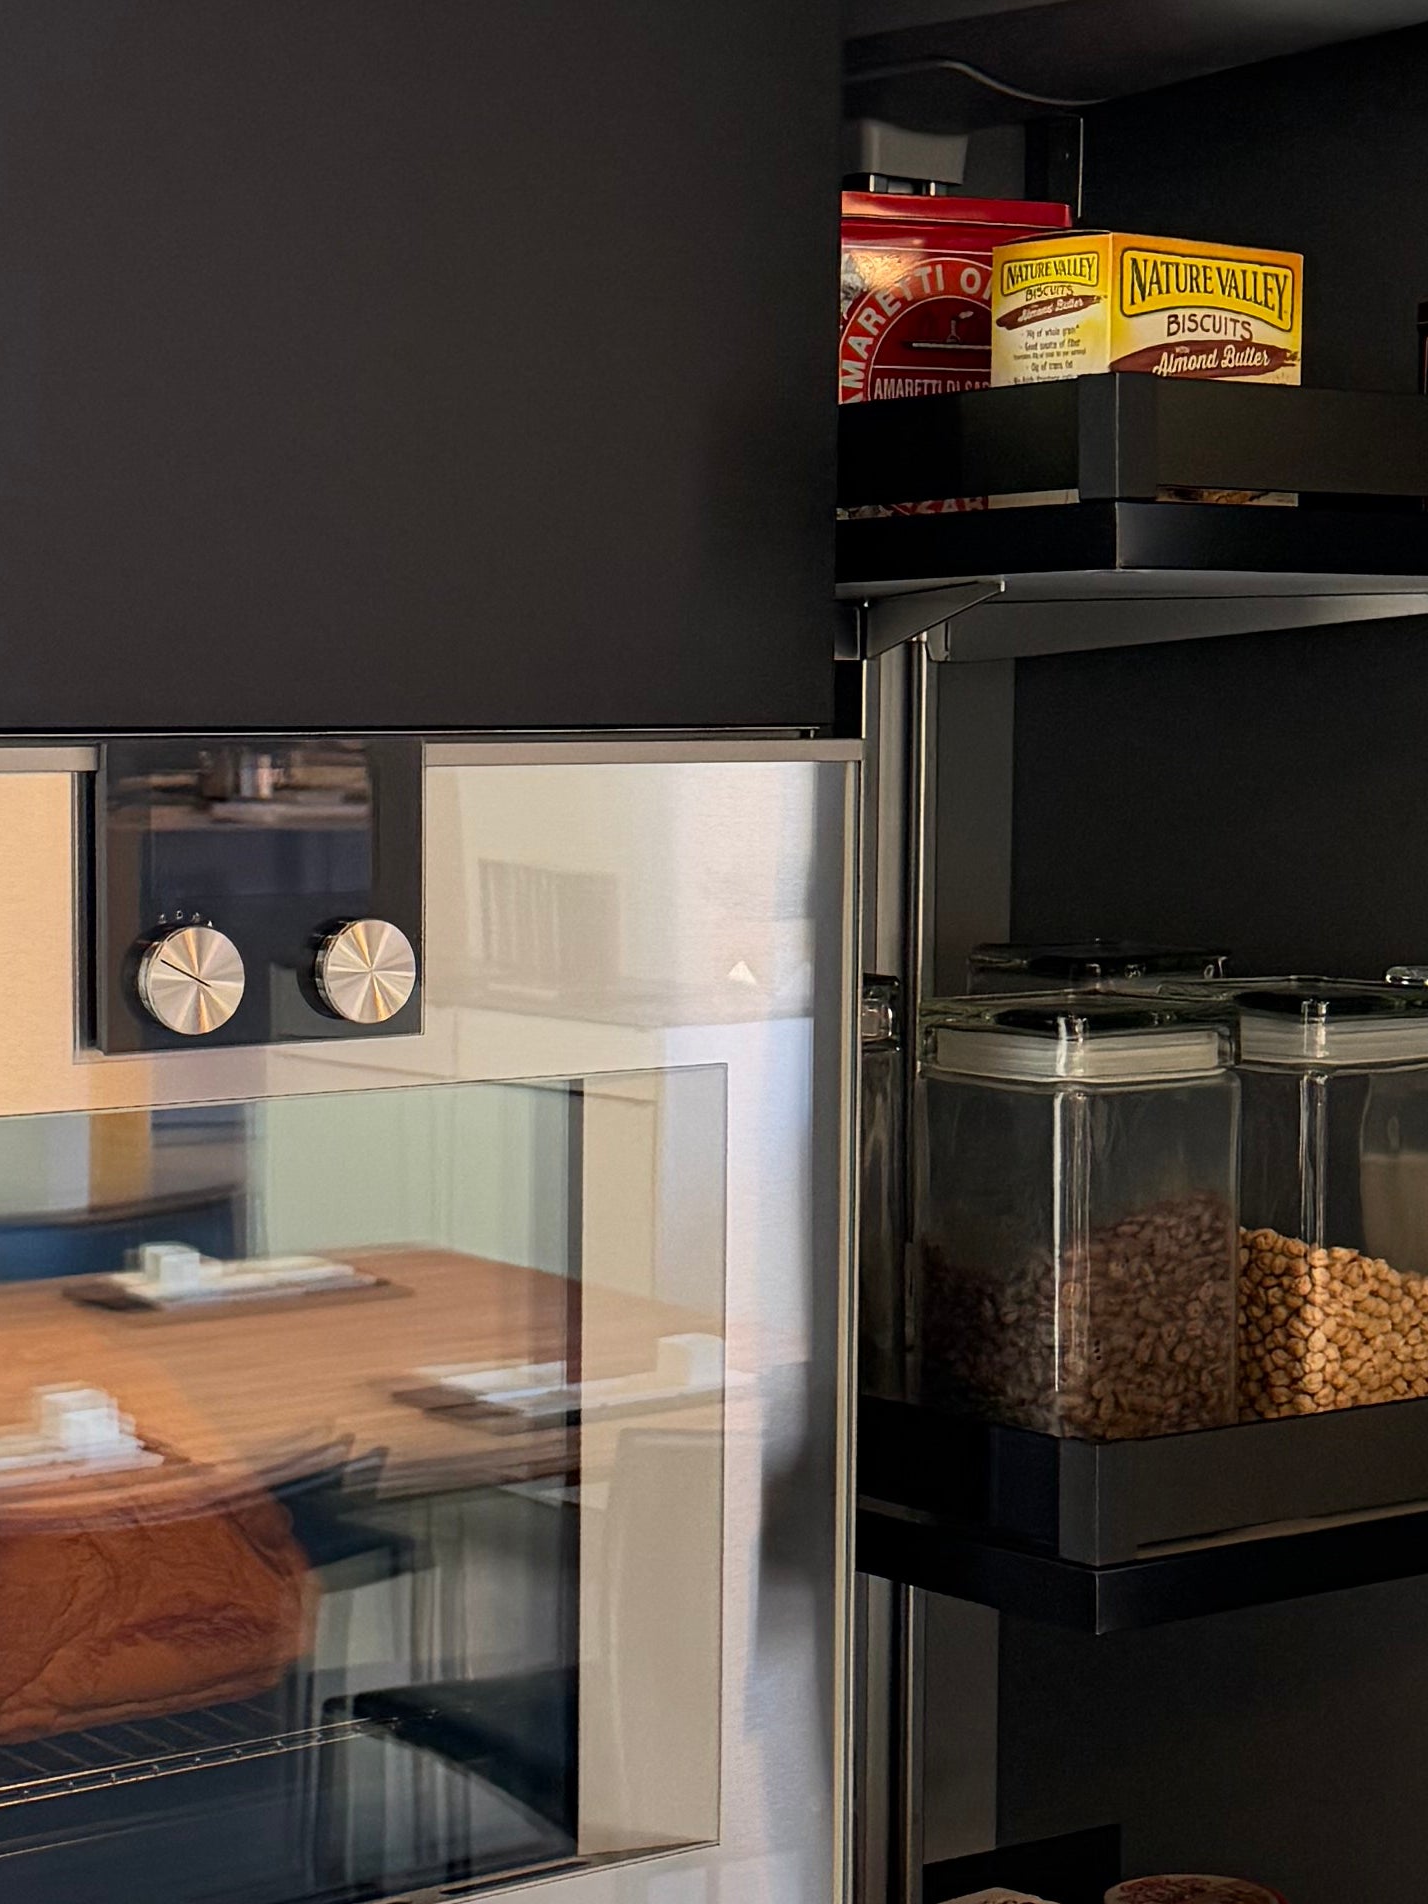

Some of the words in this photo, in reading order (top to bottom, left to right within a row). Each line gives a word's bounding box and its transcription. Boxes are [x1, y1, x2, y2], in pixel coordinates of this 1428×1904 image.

[1006, 261, 1052, 290] NATURE
[1052, 256, 1096, 281] VALLEY
[1026, 284, 1074, 302] BISCUITS
[1130, 257, 1214, 306] NATURE
[1216, 266, 1288, 321] VALLEY
[1167, 314, 1253, 342] BISCUITS
[1152, 348, 1219, 376] Almond
[1221, 345, 1270, 368] Butter
[874, 378, 942, 400] AMARETTI
